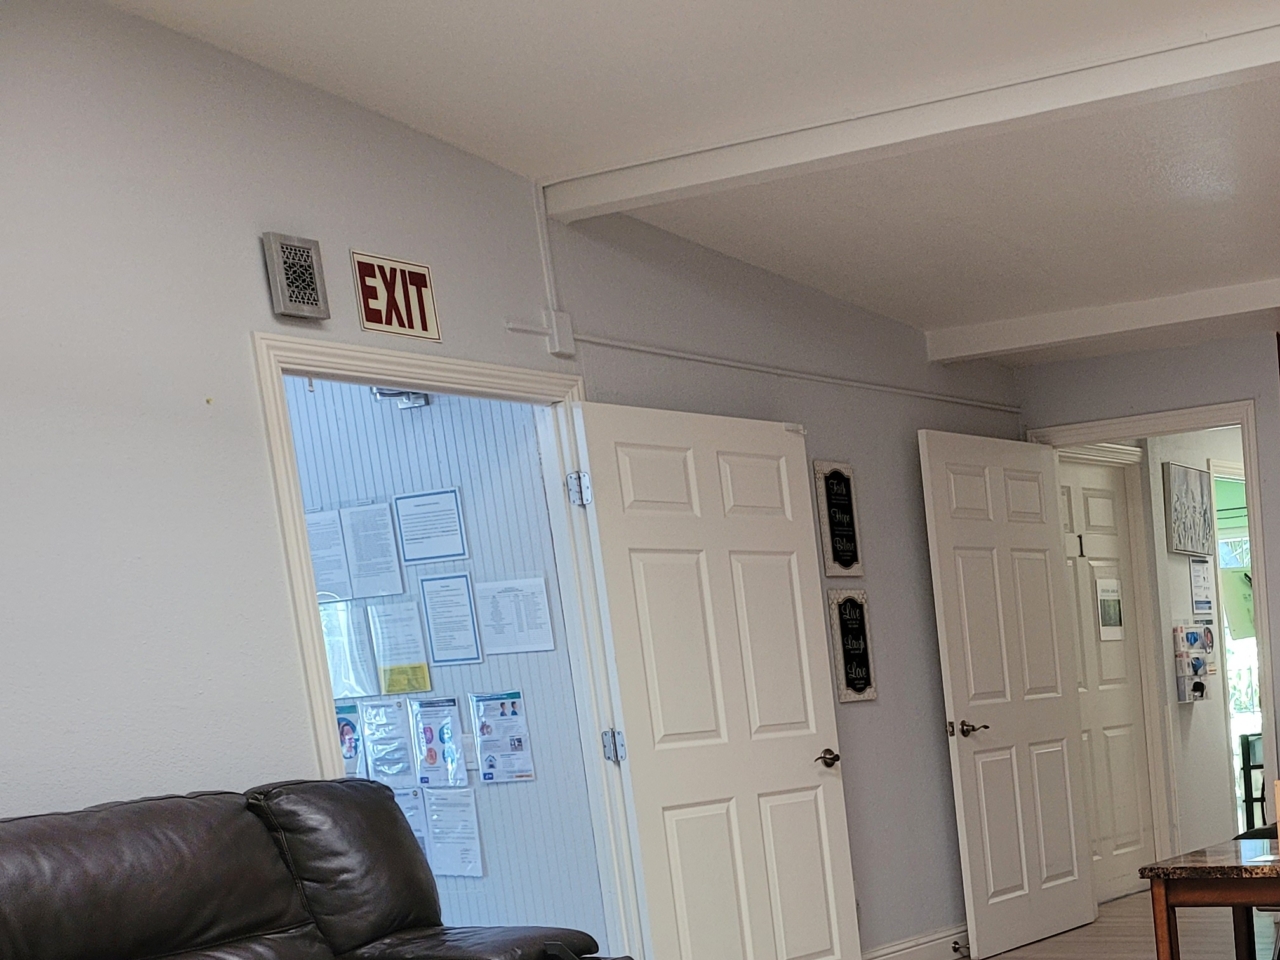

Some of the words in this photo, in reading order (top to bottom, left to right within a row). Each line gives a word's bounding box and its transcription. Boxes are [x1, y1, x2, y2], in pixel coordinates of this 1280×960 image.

[358, 261, 428, 332] EXIT
[829, 480, 846, 494] Faith
[831, 508, 850, 526] Hope
[842, 603, 860, 619] Live
[844, 635, 864, 653] Laugh
[847, 662, 867, 678] Love
